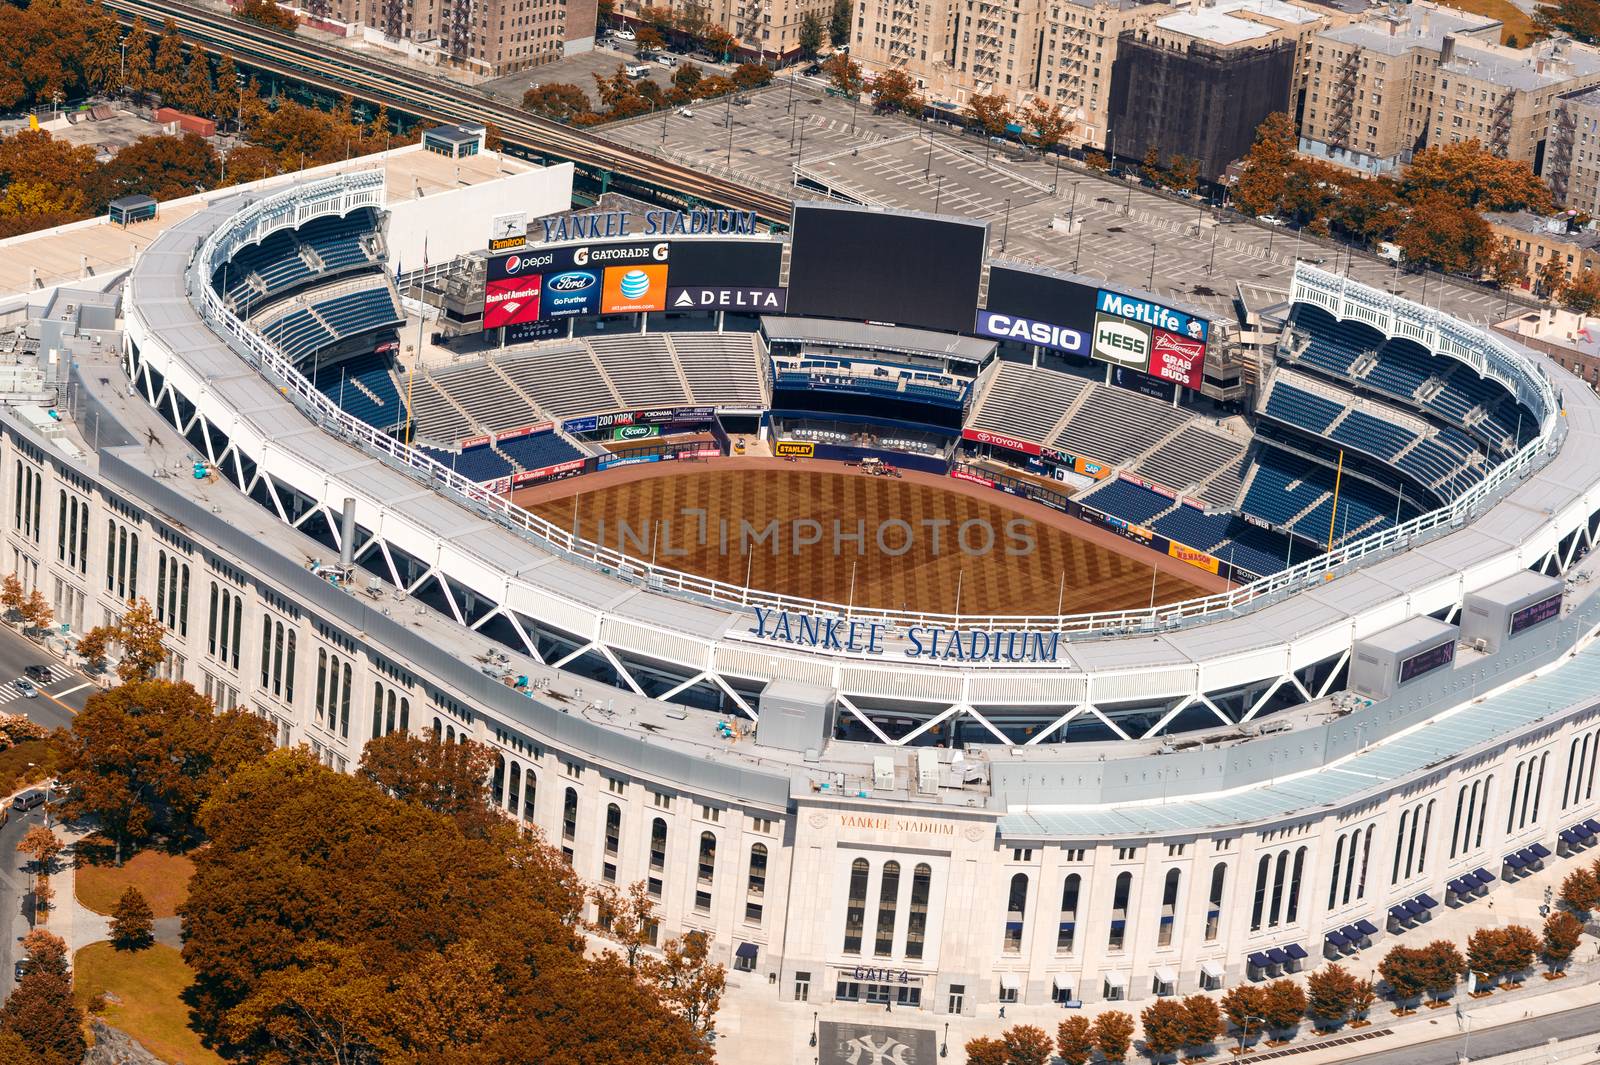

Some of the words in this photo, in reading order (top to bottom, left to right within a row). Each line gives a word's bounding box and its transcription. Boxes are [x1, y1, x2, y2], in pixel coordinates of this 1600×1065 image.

[541, 211, 632, 243] YANKEE
[644, 210, 757, 235] STADIUM
[492, 237, 526, 249] Armitron
[522, 254, 553, 269] pepsi
[591, 248, 650, 260] GATORADE
[556, 275, 587, 289] Ford
[486, 292, 503, 303] Bank
[503, 290, 511, 300] of
[510, 288, 539, 299] America
[553, 297, 564, 305] Go
[564, 296, 587, 304] Further
[700, 290, 779, 307] DELTA
[1102, 294, 1179, 331] MetLife
[988, 314, 1081, 350] CASIO
[1099, 330, 1145, 354] HESS
[1155, 335, 1199, 357] Budweiser
[1162, 353, 1192, 370] GRAB
[1167, 364, 1187, 374] SOME
[1161, 368, 1190, 384] BUDS
[598, 415, 613, 426] ZOO
[613, 412, 634, 424] YORK
[625, 426, 648, 436] Scotts
[780, 445, 810, 454] STANLEY
[991, 436, 1024, 450] TOYOTA
[1041, 447, 1076, 464] DKNY
[1084, 463, 1099, 473] SAP
[1236, 569, 1260, 580] SONY
[752, 606, 887, 654] YANKEE
[905, 627, 1060, 662] STADIUM
[841, 815, 889, 830] YANKEE
[897, 820, 954, 835] STADIUM
[854, 966, 893, 983] GATE
[899, 970, 909, 984] 4
